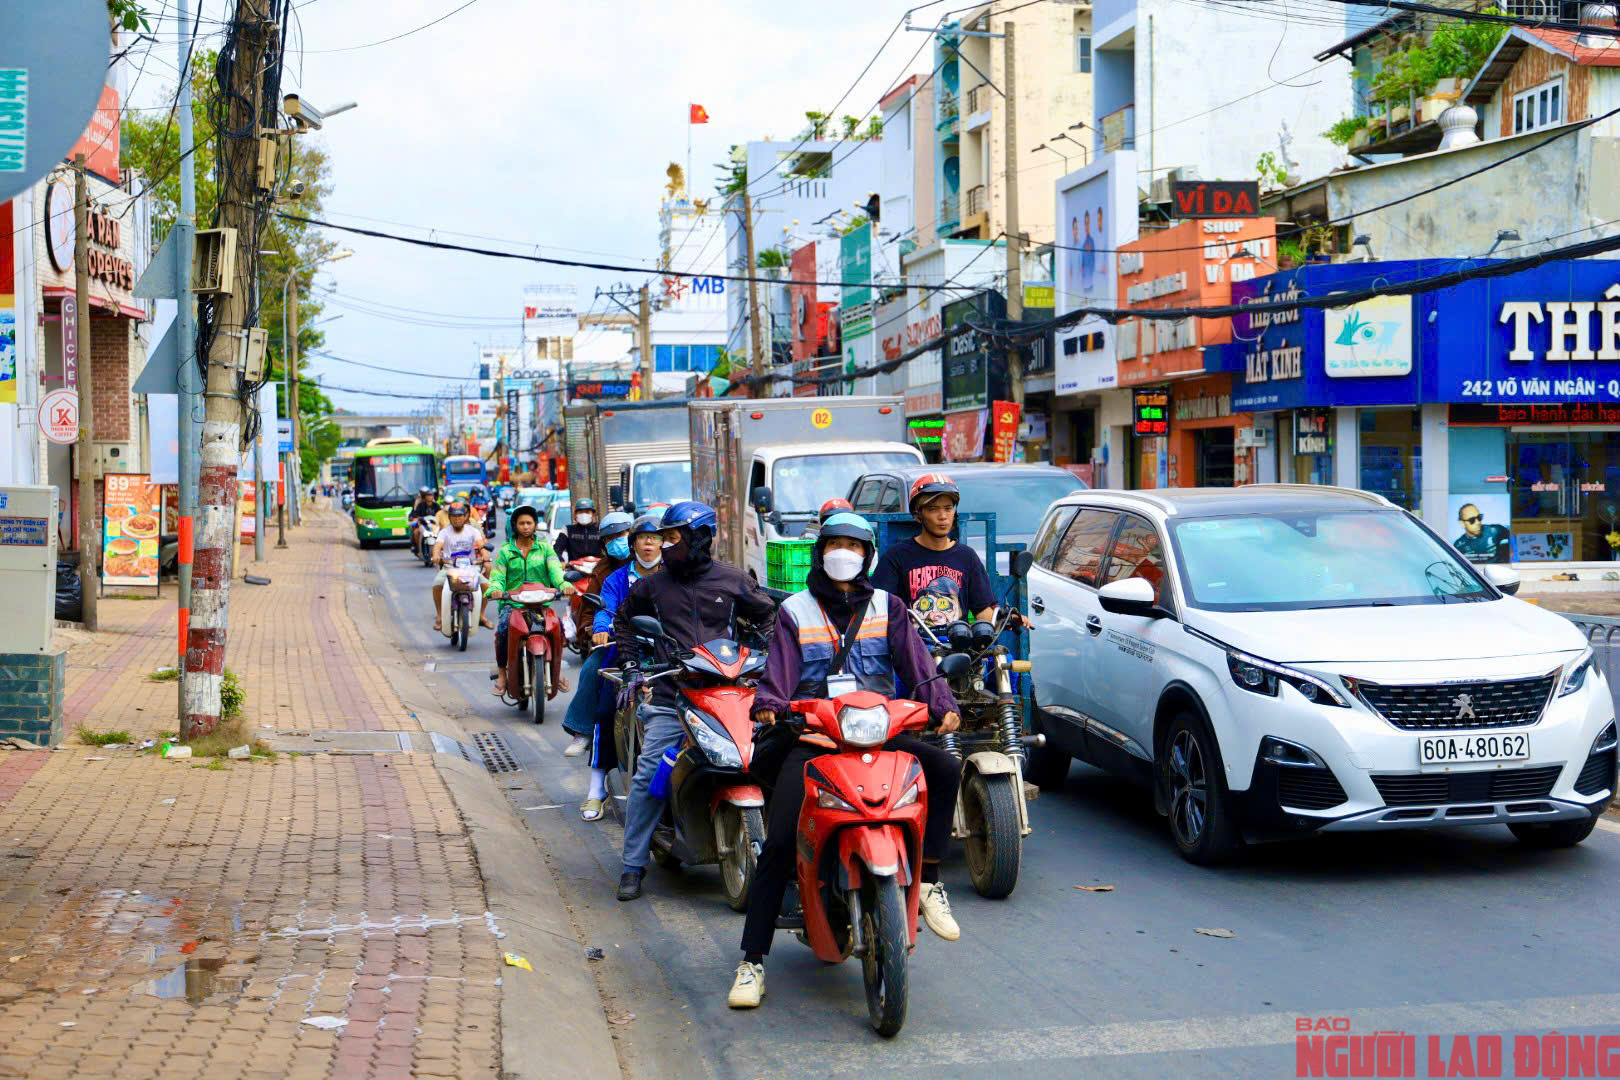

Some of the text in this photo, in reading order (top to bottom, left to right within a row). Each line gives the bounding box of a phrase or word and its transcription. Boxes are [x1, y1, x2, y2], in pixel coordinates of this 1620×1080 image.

[1176, 184, 1254, 214] VÍ DA
[1203, 221, 1244, 233] SHOP
[1231, 263, 1256, 282] DA
[692, 277, 725, 294] MB
[1271, 338, 1301, 380] KÍNH
[1462, 381, 1492, 396] 242
[1497, 377, 1518, 396] VÕ
[1521, 377, 1549, 396] VĂN
[1554, 377, 1596, 396] NGÂN
[815, 412, 829, 425] 02
[108, 476, 128, 490] 89
[1424, 735, 1525, 760] 60A-480.62
